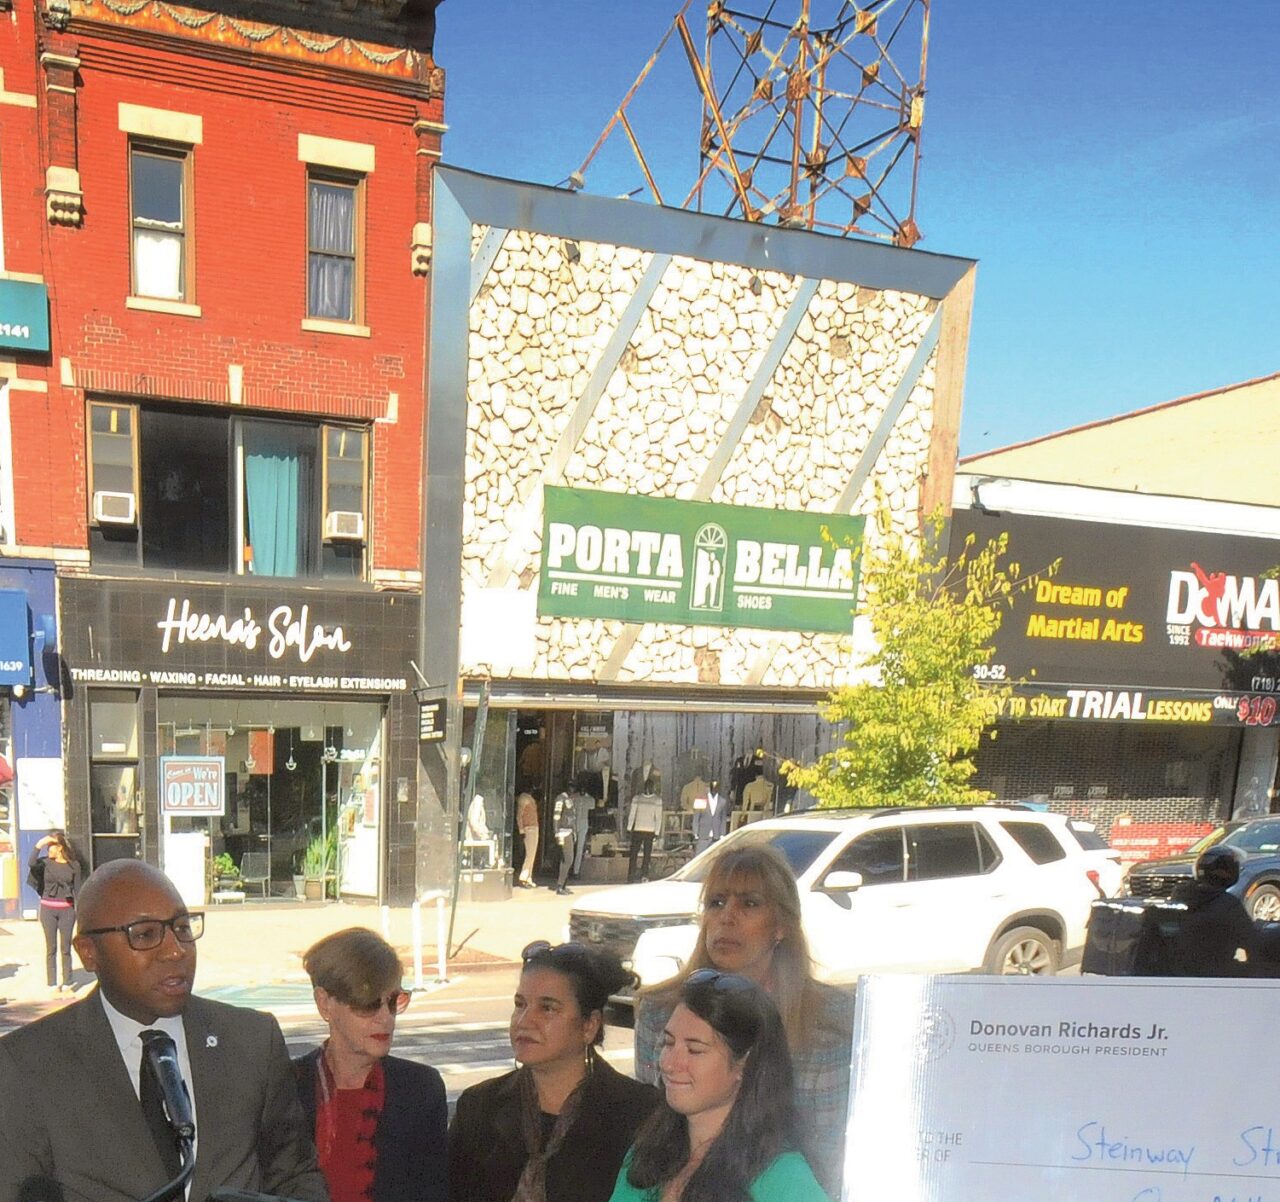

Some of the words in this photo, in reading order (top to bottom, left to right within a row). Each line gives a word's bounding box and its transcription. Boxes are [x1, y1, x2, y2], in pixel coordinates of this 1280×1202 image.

[547, 522, 684, 577] PORTA
[734, 540, 854, 590] BELLA
[551, 582, 578, 596] FINE
[594, 584, 629, 600] MEN'S
[644, 589, 676, 604] WEAR
[737, 594, 772, 610] SHOES
[1036, 581, 1102, 606] Dream
[1106, 586, 1129, 608] of
[157, 598, 261, 653] Heena's
[268, 604, 352, 663] Salon
[1026, 615, 1099, 640] Martial
[1101, 618, 1144, 643] Arts
[1166, 624, 1191, 636] SINCE
[1169, 635, 1190, 646] 1992
[70, 668, 141, 683] THREADING
[150, 671, 197, 685] WAXING
[205, 673, 246, 686] FACIAL
[254, 674, 281, 687] HAIR
[289, 675, 338, 688] EYELASH
[340, 677, 407, 690] EXTENSIONS
[972, 664, 1006, 680] 30-52
[1251, 676, 1275, 692] (718)
[1009, 697, 1027, 716] TO
[1029, 698, 1068, 717] START
[1066, 690, 1147, 719] TRIAL
[1147, 701, 1213, 722] LESSONS
[1213, 696, 1239, 710] ONLY
[1237, 695, 1277, 727] $10
[193, 766, 218, 780] We're
[167, 782, 218, 806] OPEN
[970, 1020, 1052, 1037] Donovan
[1058, 1021, 1141, 1039] Richards
[1147, 1023, 1169, 1040] Jr.
[968, 1042, 1019, 1053] QUEENS
[1024, 1044, 1090, 1055] BOROUGH
[1095, 1046, 1168, 1057] PRESIDENT
[937, 1131, 963, 1146] THE
[934, 1149, 951, 1161] OF
[1071, 1121, 1196, 1182] Steinway
